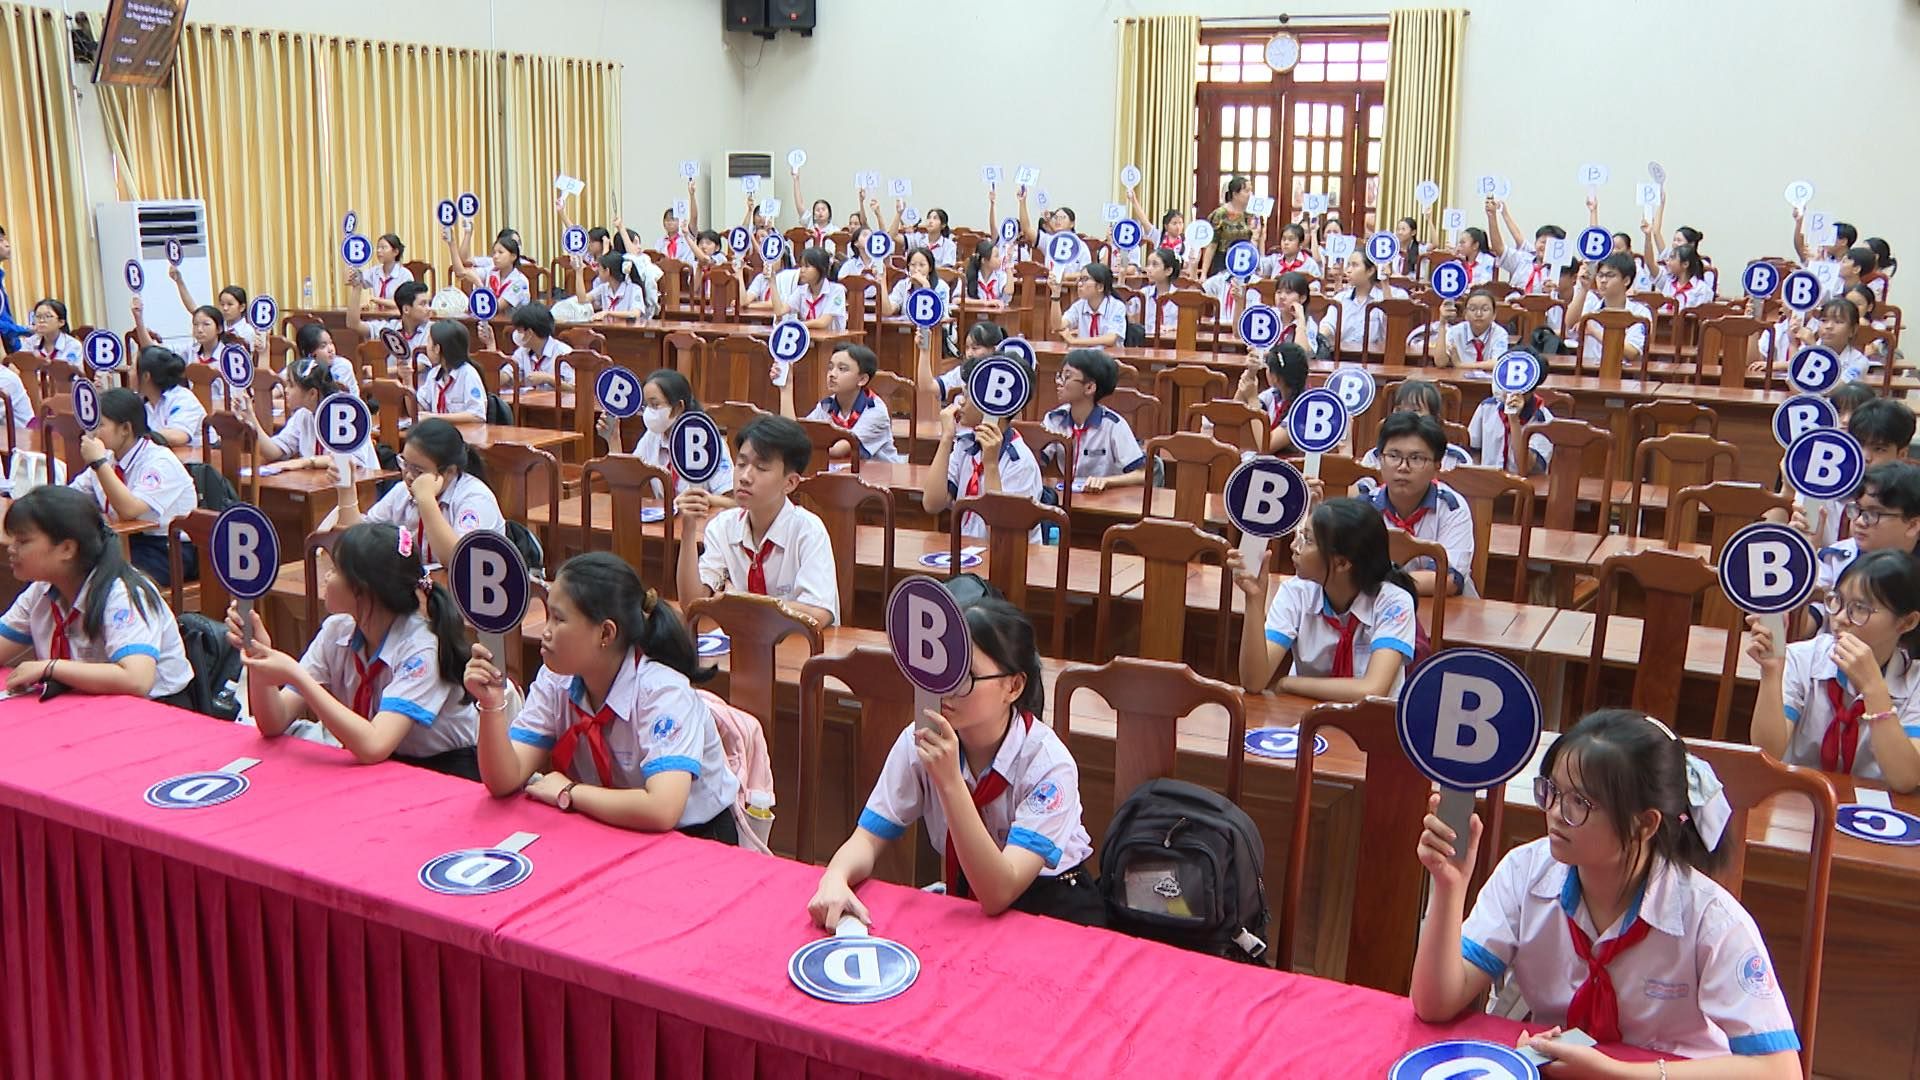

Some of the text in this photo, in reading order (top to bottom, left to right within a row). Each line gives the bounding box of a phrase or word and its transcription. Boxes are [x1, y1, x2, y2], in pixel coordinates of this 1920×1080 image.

[1128, 170, 1135, 181] B
[1588, 167, 1600, 179] B
[895, 180, 904, 192] B
[1424, 185, 1435, 199] B
[1483, 177, 1495, 192] B
[1644, 186, 1655, 201] B
[442, 206, 453, 223] B
[462, 197, 474, 214] B
[677, 201, 686, 212] B
[1108, 207, 1119, 219] B
[1253, 200, 1264, 212] B
[346, 214, 355, 231] B
[1005, 222, 1015, 238] B
[1451, 213, 1461, 226] B
[1812, 214, 1823, 230] B
[570, 233, 582, 250] B
[733, 230, 746, 247] B
[1119, 223, 1135, 245] B
[1195, 225, 1208, 238] B
[170, 241, 179, 260] B
[349, 240, 365, 260] B
[768, 239, 781, 256] B
[872, 235, 886, 254] B
[1054, 240, 1073, 260] B
[1333, 237, 1346, 251] B
[1375, 236, 1391, 257] B
[1553, 242, 1565, 258] B
[1588, 232, 1604, 254] B
[1234, 249, 1250, 269] B
[130, 265, 139, 285] B
[1441, 269, 1458, 292] B
[1752, 268, 1771, 292] B
[1818, 266, 1831, 282] B
[1792, 277, 1811, 304] B
[257, 303, 270, 324] B
[476, 293, 490, 316] B
[916, 295, 935, 320] B
[1250, 315, 1271, 340] B
[388, 333, 401, 353] B
[776, 326, 800, 354] B
[95, 339, 114, 363] B
[228, 354, 246, 379] B
[1505, 361, 1529, 387] B
[1796, 352, 1831, 386] B
[604, 374, 632, 409] B
[983, 368, 1013, 406] B
[1339, 375, 1362, 407] B
[79, 386, 94, 417] B
[330, 403, 357, 444] B
[1304, 401, 1333, 440] B
[684, 427, 709, 471] B
[1804, 440, 1846, 486] B
[1241, 469, 1289, 525] B
[228, 522, 261, 580] B
[1748, 541, 1793, 598] B
[469, 547, 508, 617] B
[908, 592, 948, 675] B
[1432, 672, 1504, 764] B
[1852, 815, 1908, 838] C
[445, 857, 511, 886] D
[824, 947, 881, 986] D
